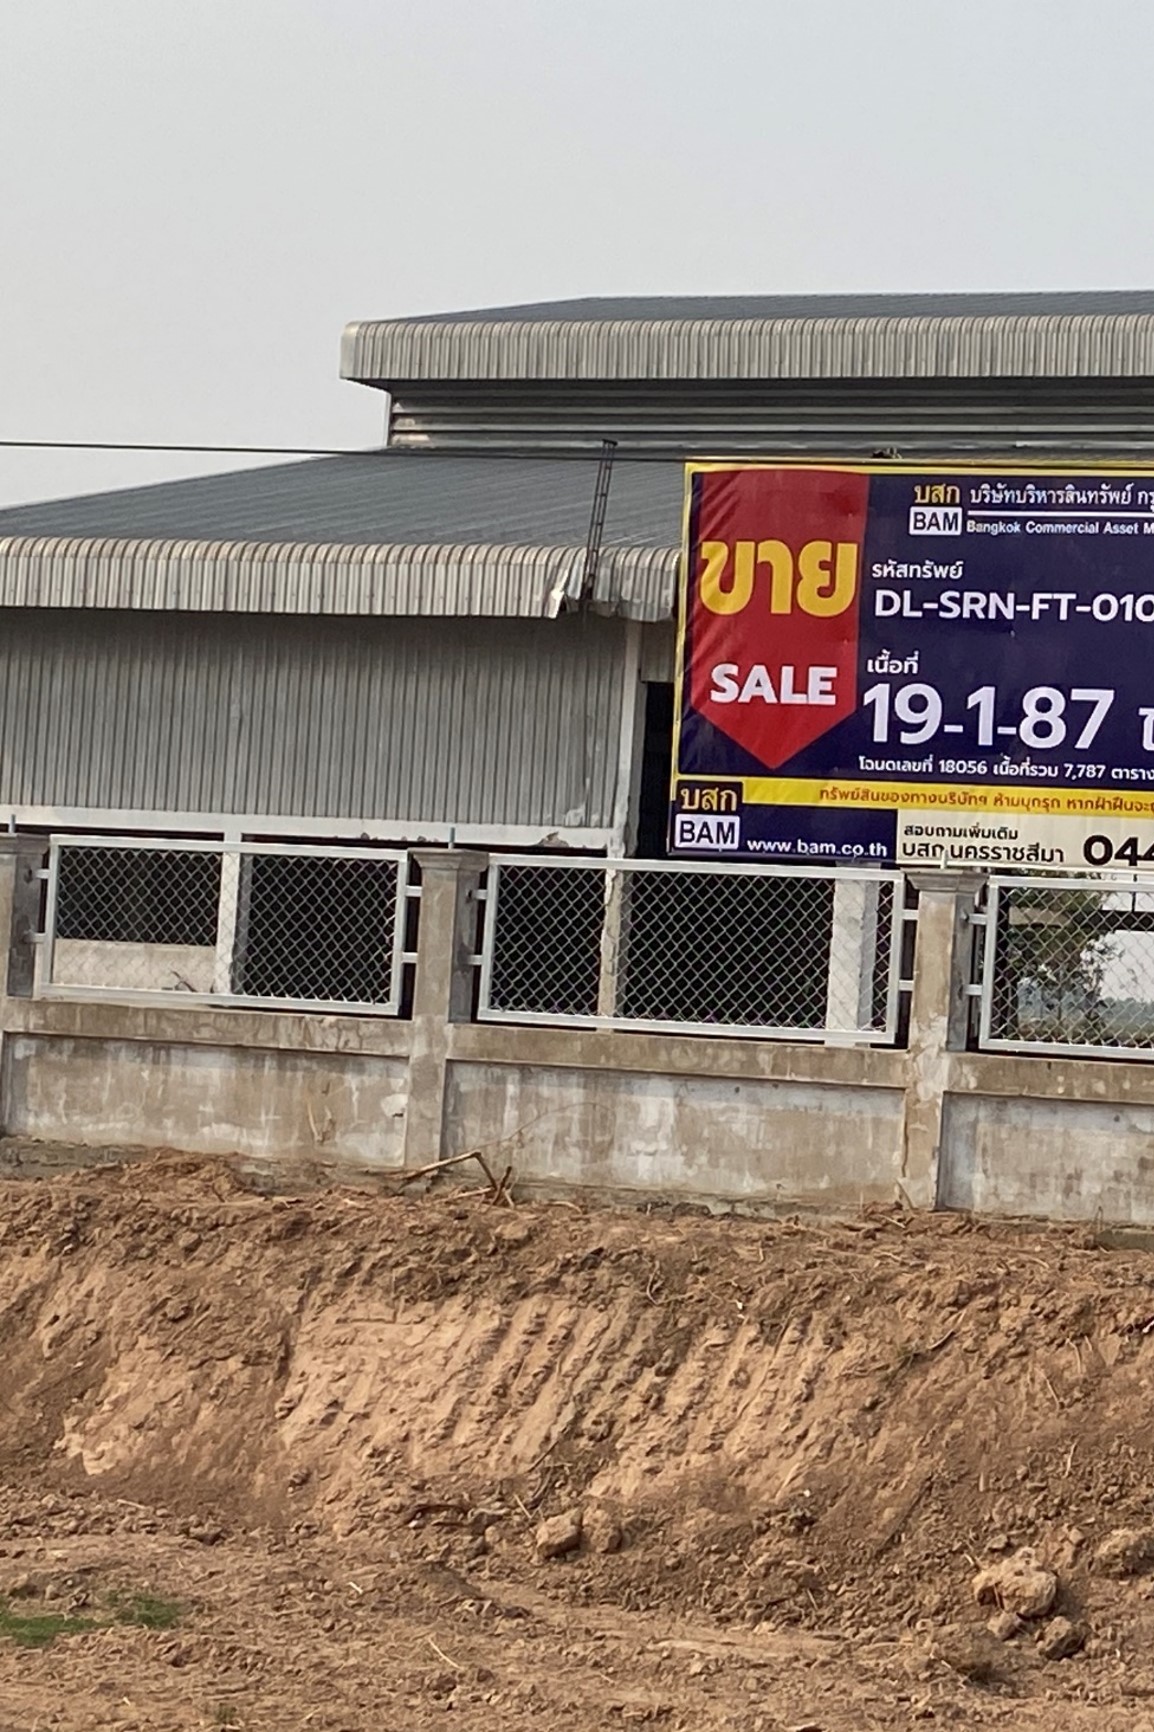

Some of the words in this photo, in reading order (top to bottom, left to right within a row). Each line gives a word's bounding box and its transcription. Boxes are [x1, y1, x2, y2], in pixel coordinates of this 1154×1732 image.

[914, 484, 960, 503] บสก
[970, 483, 1134, 505] บริษัทบริหารสินทรัพย์
[913, 511, 959, 532] BAM
[966, 519, 1020, 535] Bangkok
[1025, 520, 1099, 535] Commercial
[1103, 522, 1138, 535] Asset
[699, 540, 858, 618] ขาย
[872, 559, 965, 580] รหัสทรัพย์
[867, 648, 920, 674] เนื้อที่
[710, 662, 838, 706] SALE
[862, 682, 1116, 750] 19-1-87
[858, 755, 933, 773] โฉนดเลขที่
[938, 759, 988, 775] 18056
[993, 755, 1058, 778] เนื้อที่รวม
[1063, 763, 1106, 781] 7,787
[680, 786, 738, 812] บสก
[819, 785, 987, 807] ทรัพย์สินของทางบริษัทฯ
[993, 791, 1061, 812] ห้ามบุกรุก
[679, 820, 736, 845] BAM
[904, 823, 1019, 841] สอบถามเพิ่มเติม
[746, 837, 888, 858] www.bam.co.th
[950, 843, 1064, 863] นครราชสีมา
